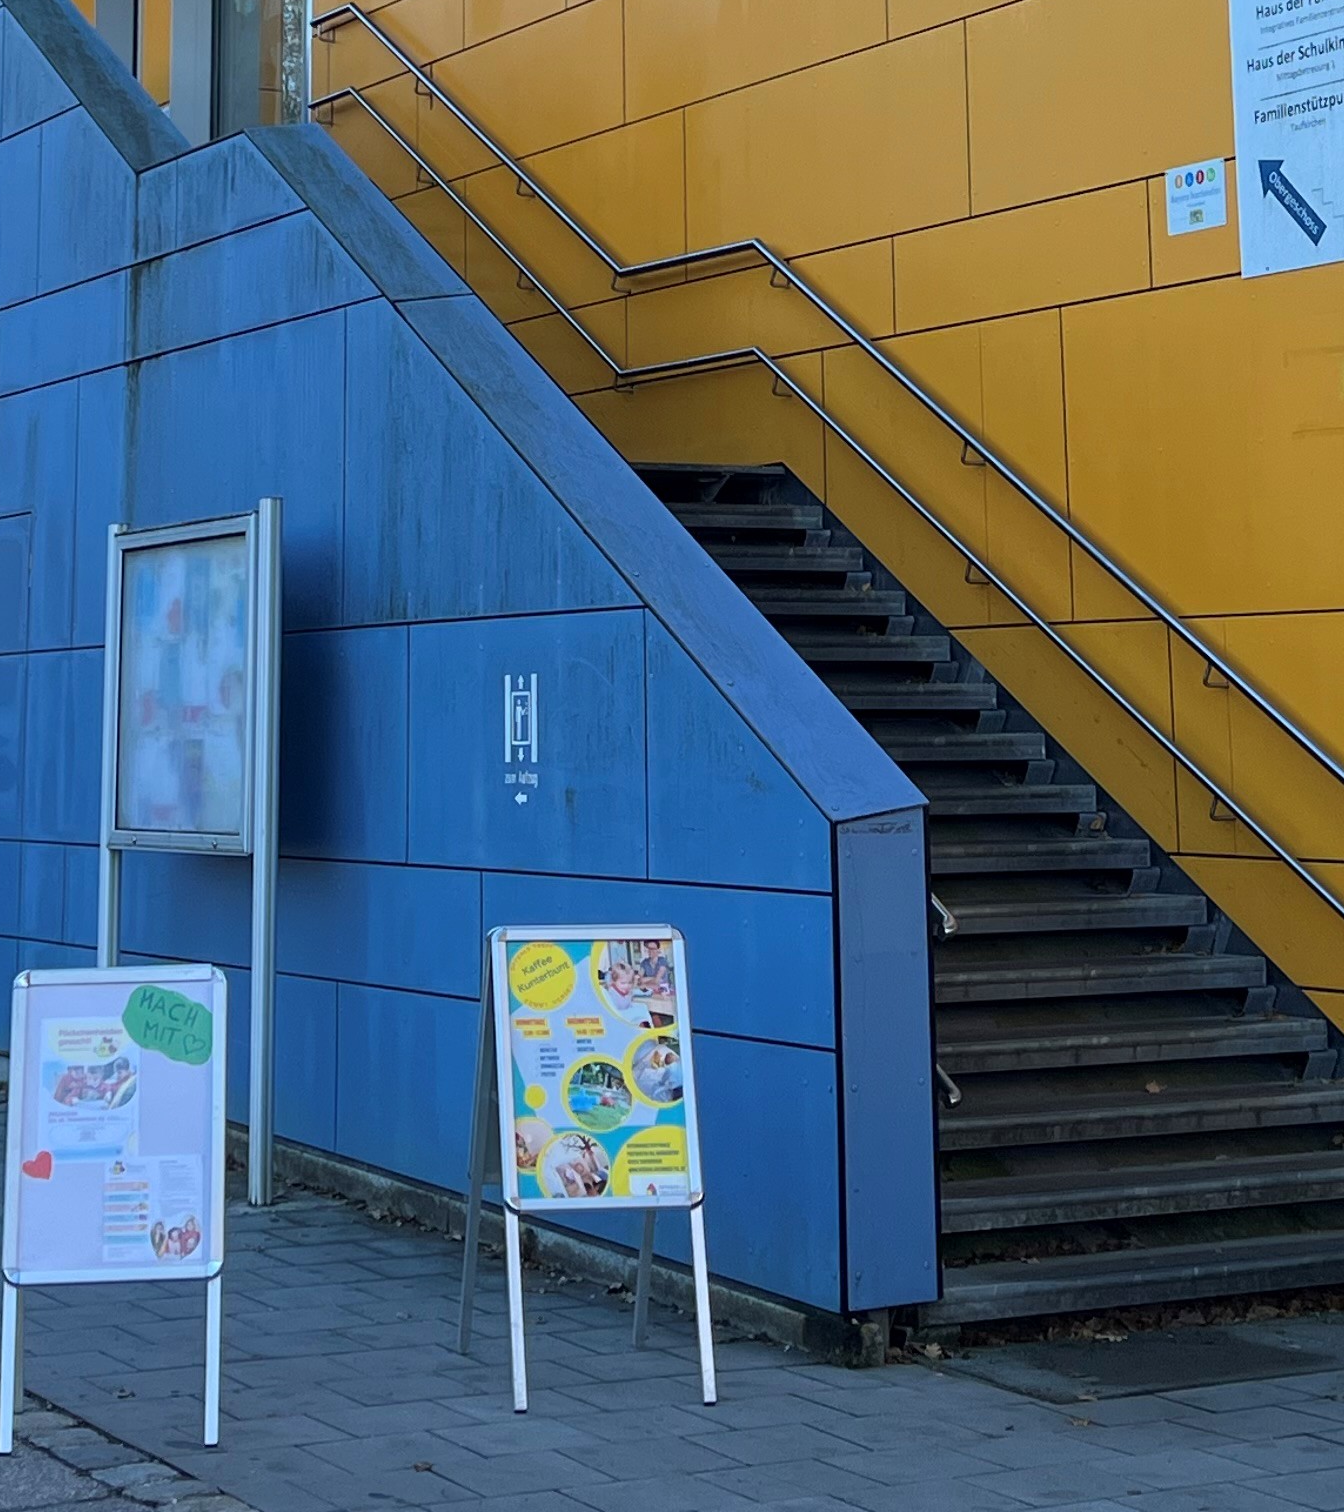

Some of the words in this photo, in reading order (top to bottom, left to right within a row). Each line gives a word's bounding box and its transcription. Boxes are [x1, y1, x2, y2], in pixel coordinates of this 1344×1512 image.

[1256, 3, 1284, 20] Haus
[1247, 56, 1274, 73] Haus
[1276, 49, 1296, 66] der
[1268, 171, 1320, 236] Obergeschoss
[517, 961, 571, 993] Kunterbunt
[521, 956, 553, 976] Kaffee
[139, 989, 199, 1028] MACH
[143, 1020, 183, 1045] MIT
